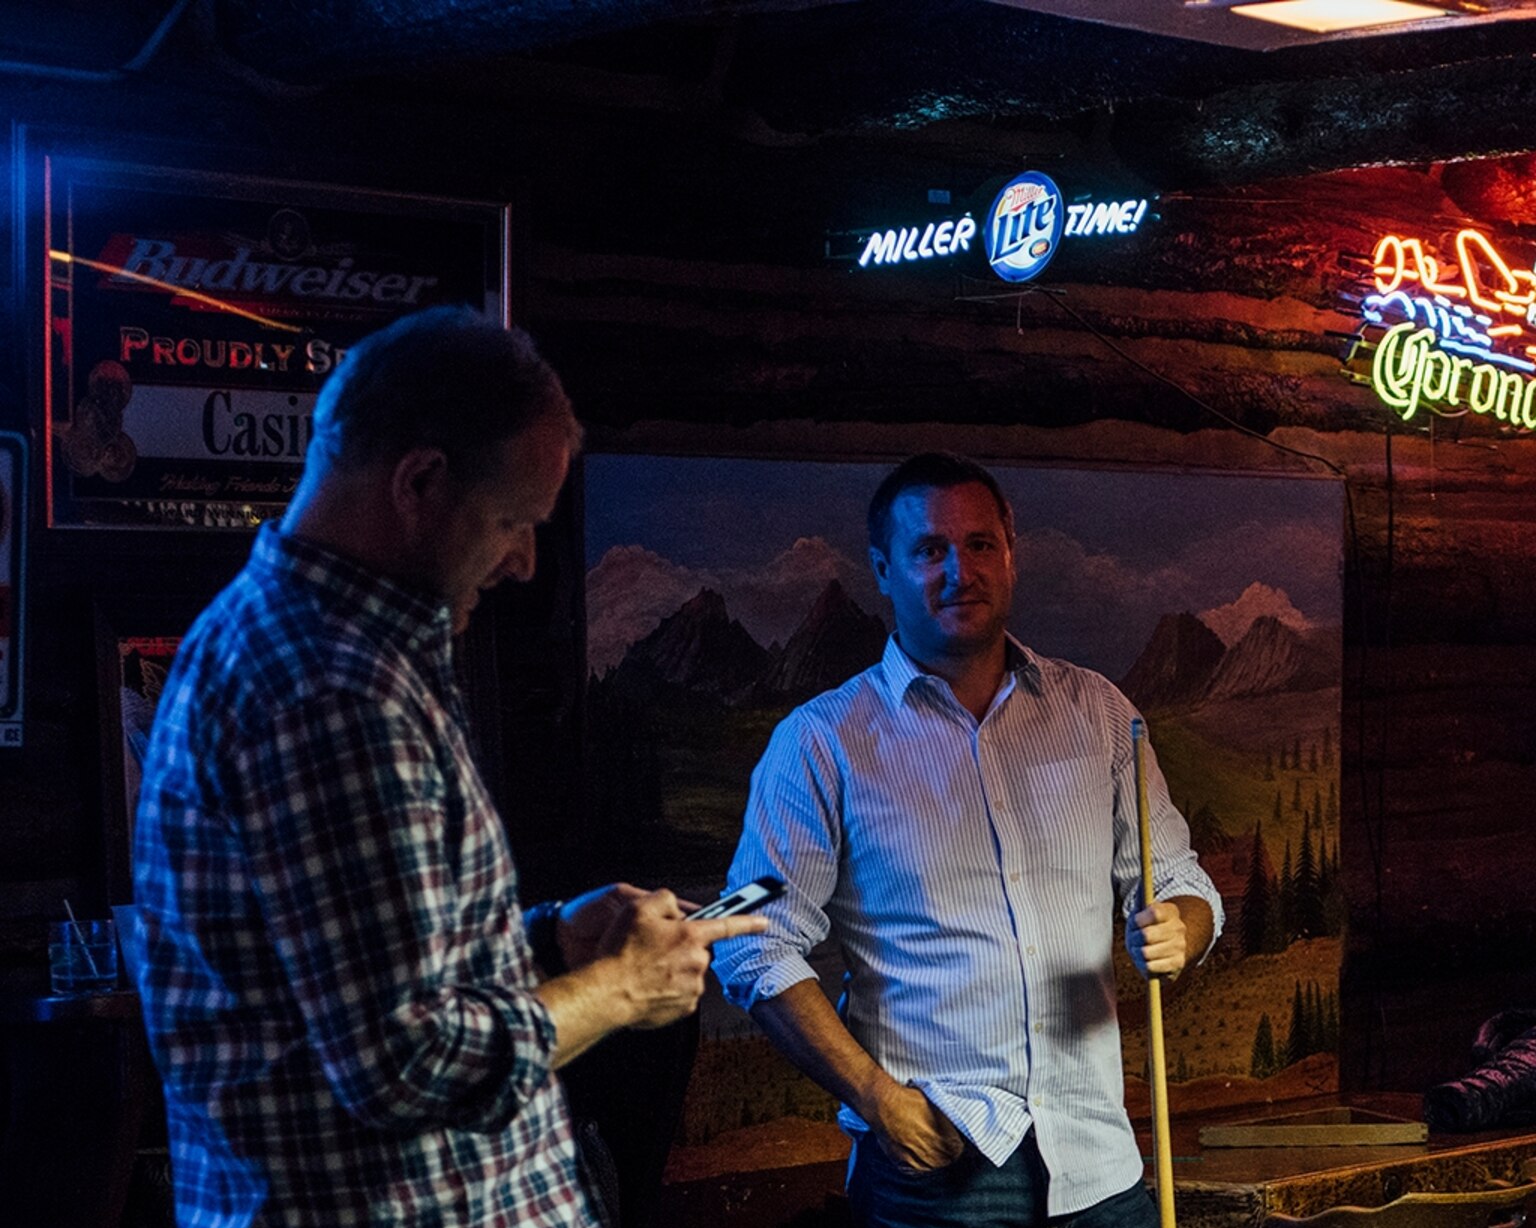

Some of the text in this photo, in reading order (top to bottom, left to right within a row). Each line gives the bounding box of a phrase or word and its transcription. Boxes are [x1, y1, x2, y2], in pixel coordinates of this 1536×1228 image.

[858, 217, 976, 267] MILLER
[992, 195, 1056, 262] Lite
[1064, 198, 1147, 236] TIME!
[107, 237, 439, 304] Budweiser
[119, 324, 296, 373] PROUDLY
[202, 391, 315, 457] Casi
